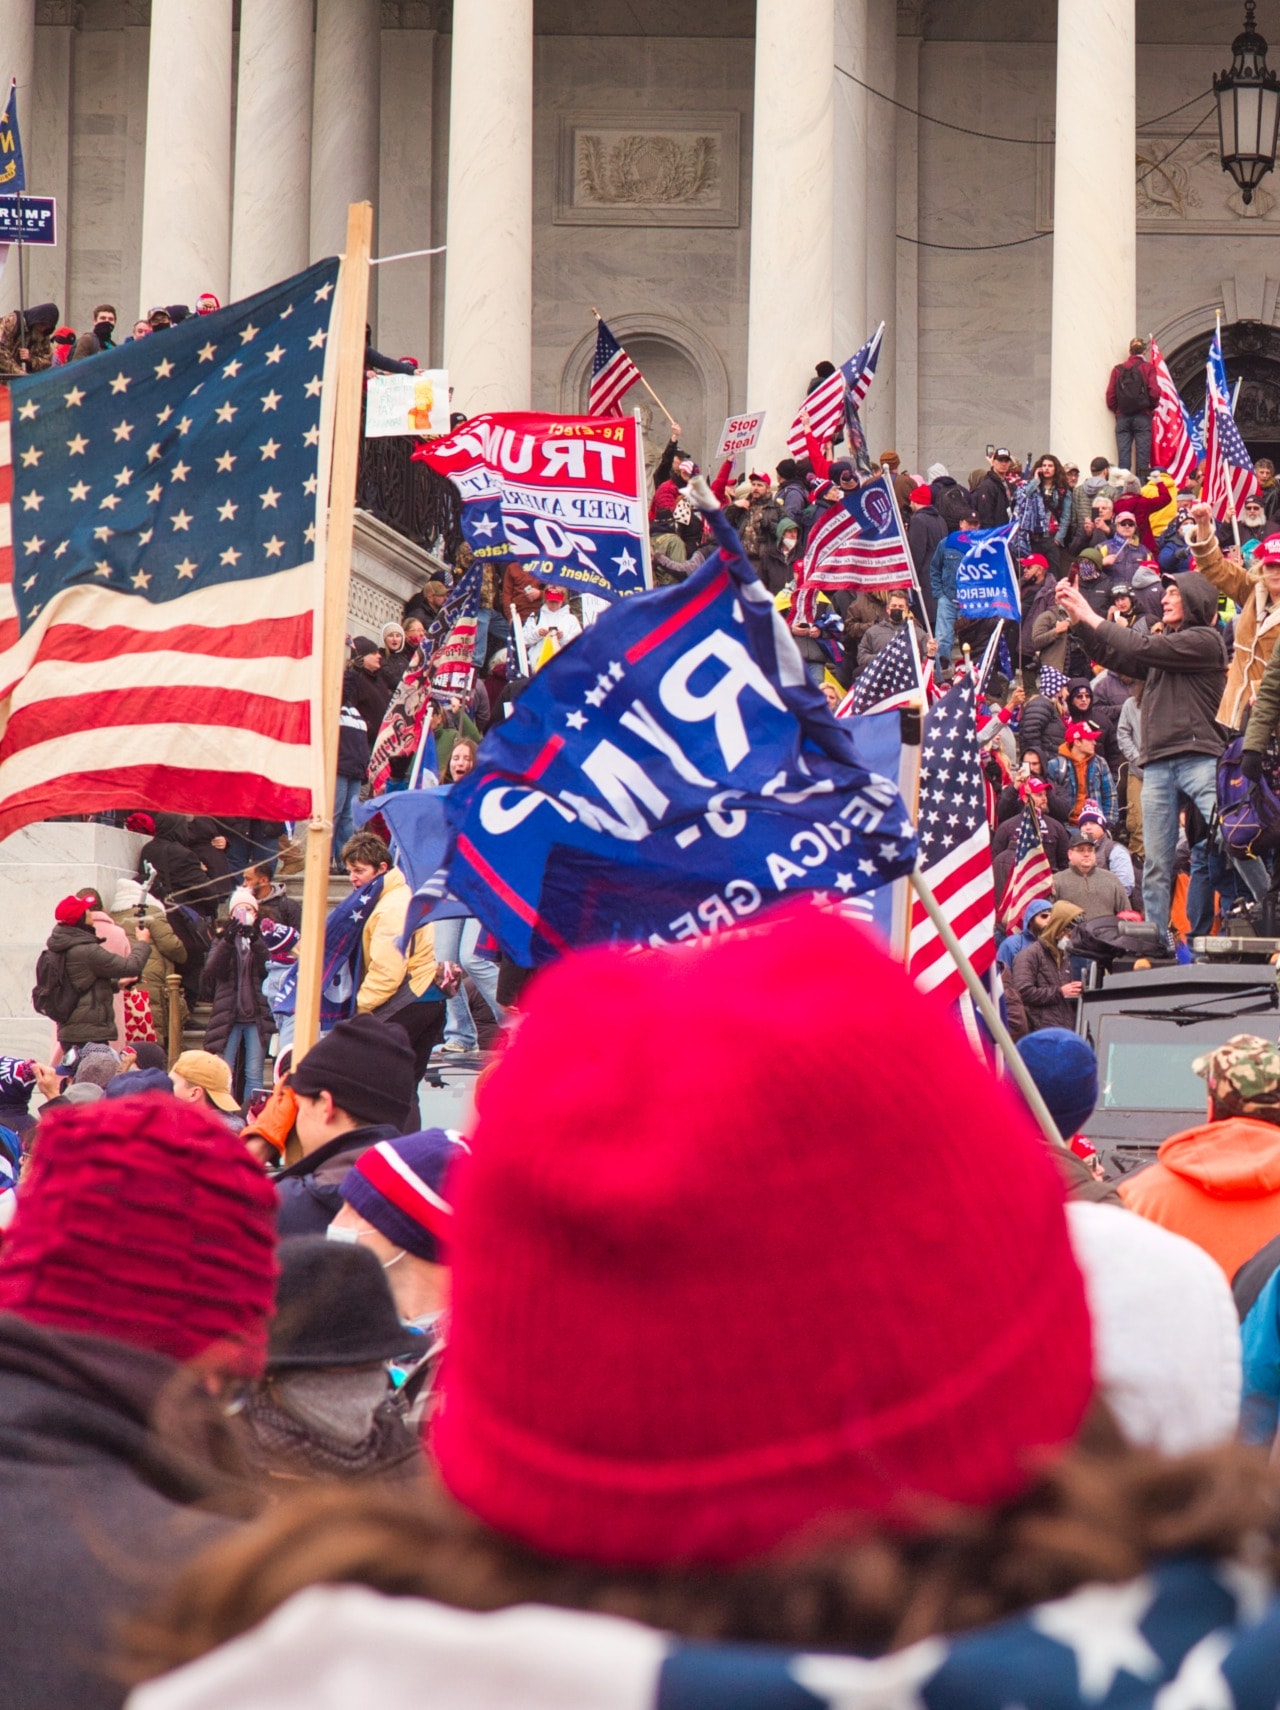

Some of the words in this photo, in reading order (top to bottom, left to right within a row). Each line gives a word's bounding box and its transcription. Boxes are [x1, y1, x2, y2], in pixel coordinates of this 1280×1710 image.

[0, 208, 51, 219] RUMP
[4, 219, 46, 227] ENCE
[729, 419, 758, 433] Stop
[723, 434, 755, 451] Steal
